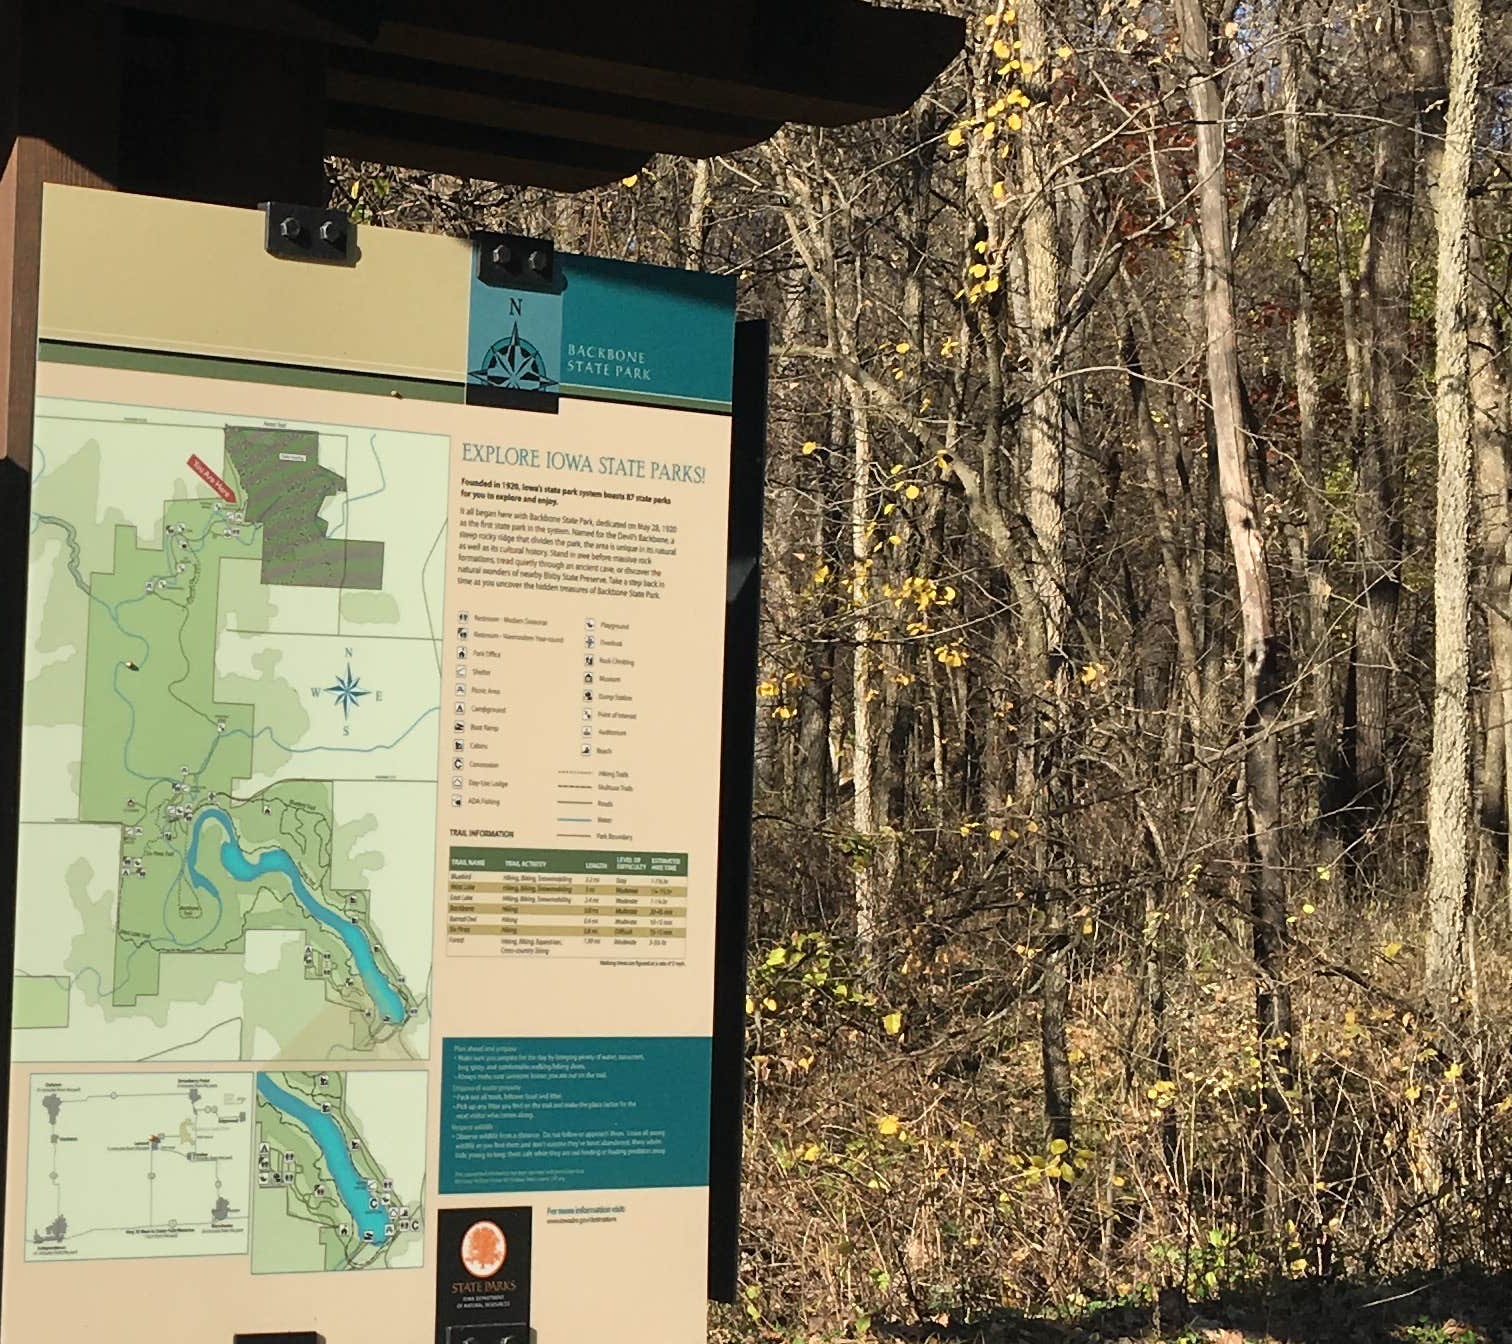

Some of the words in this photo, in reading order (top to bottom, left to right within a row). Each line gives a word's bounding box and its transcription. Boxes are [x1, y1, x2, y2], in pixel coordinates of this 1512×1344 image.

[508, 298, 522, 316] N
[568, 344, 646, 364] BACKBONE
[567, 360, 610, 376] STATE
[616, 366, 652, 380] PARK
[462, 442, 541, 468] EXPLORE
[546, 451, 593, 473] IOWA
[598, 456, 646, 478] STATE
[650, 462, 706, 484] PARKS!
[460, 488, 470, 497] for
[472, 491, 485, 501] you
[495, 491, 521, 504] explore
[523, 494, 536, 503] and
[461, 476, 492, 487] Founded
[544, 484, 560, 494] state
[561, 485, 577, 498] park
[579, 487, 602, 500] system
[635, 492, 651, 502] state
[652, 494, 671, 506] parks
[344, 648, 352, 658] N
[310, 688, 322, 698] W
[376, 690, 382, 702] E
[343, 726, 350, 736] S
[450, 829, 466, 837] TRAIL
[468, 829, 514, 838] INFORMATION
[451, 1282, 482, 1294] STATE
